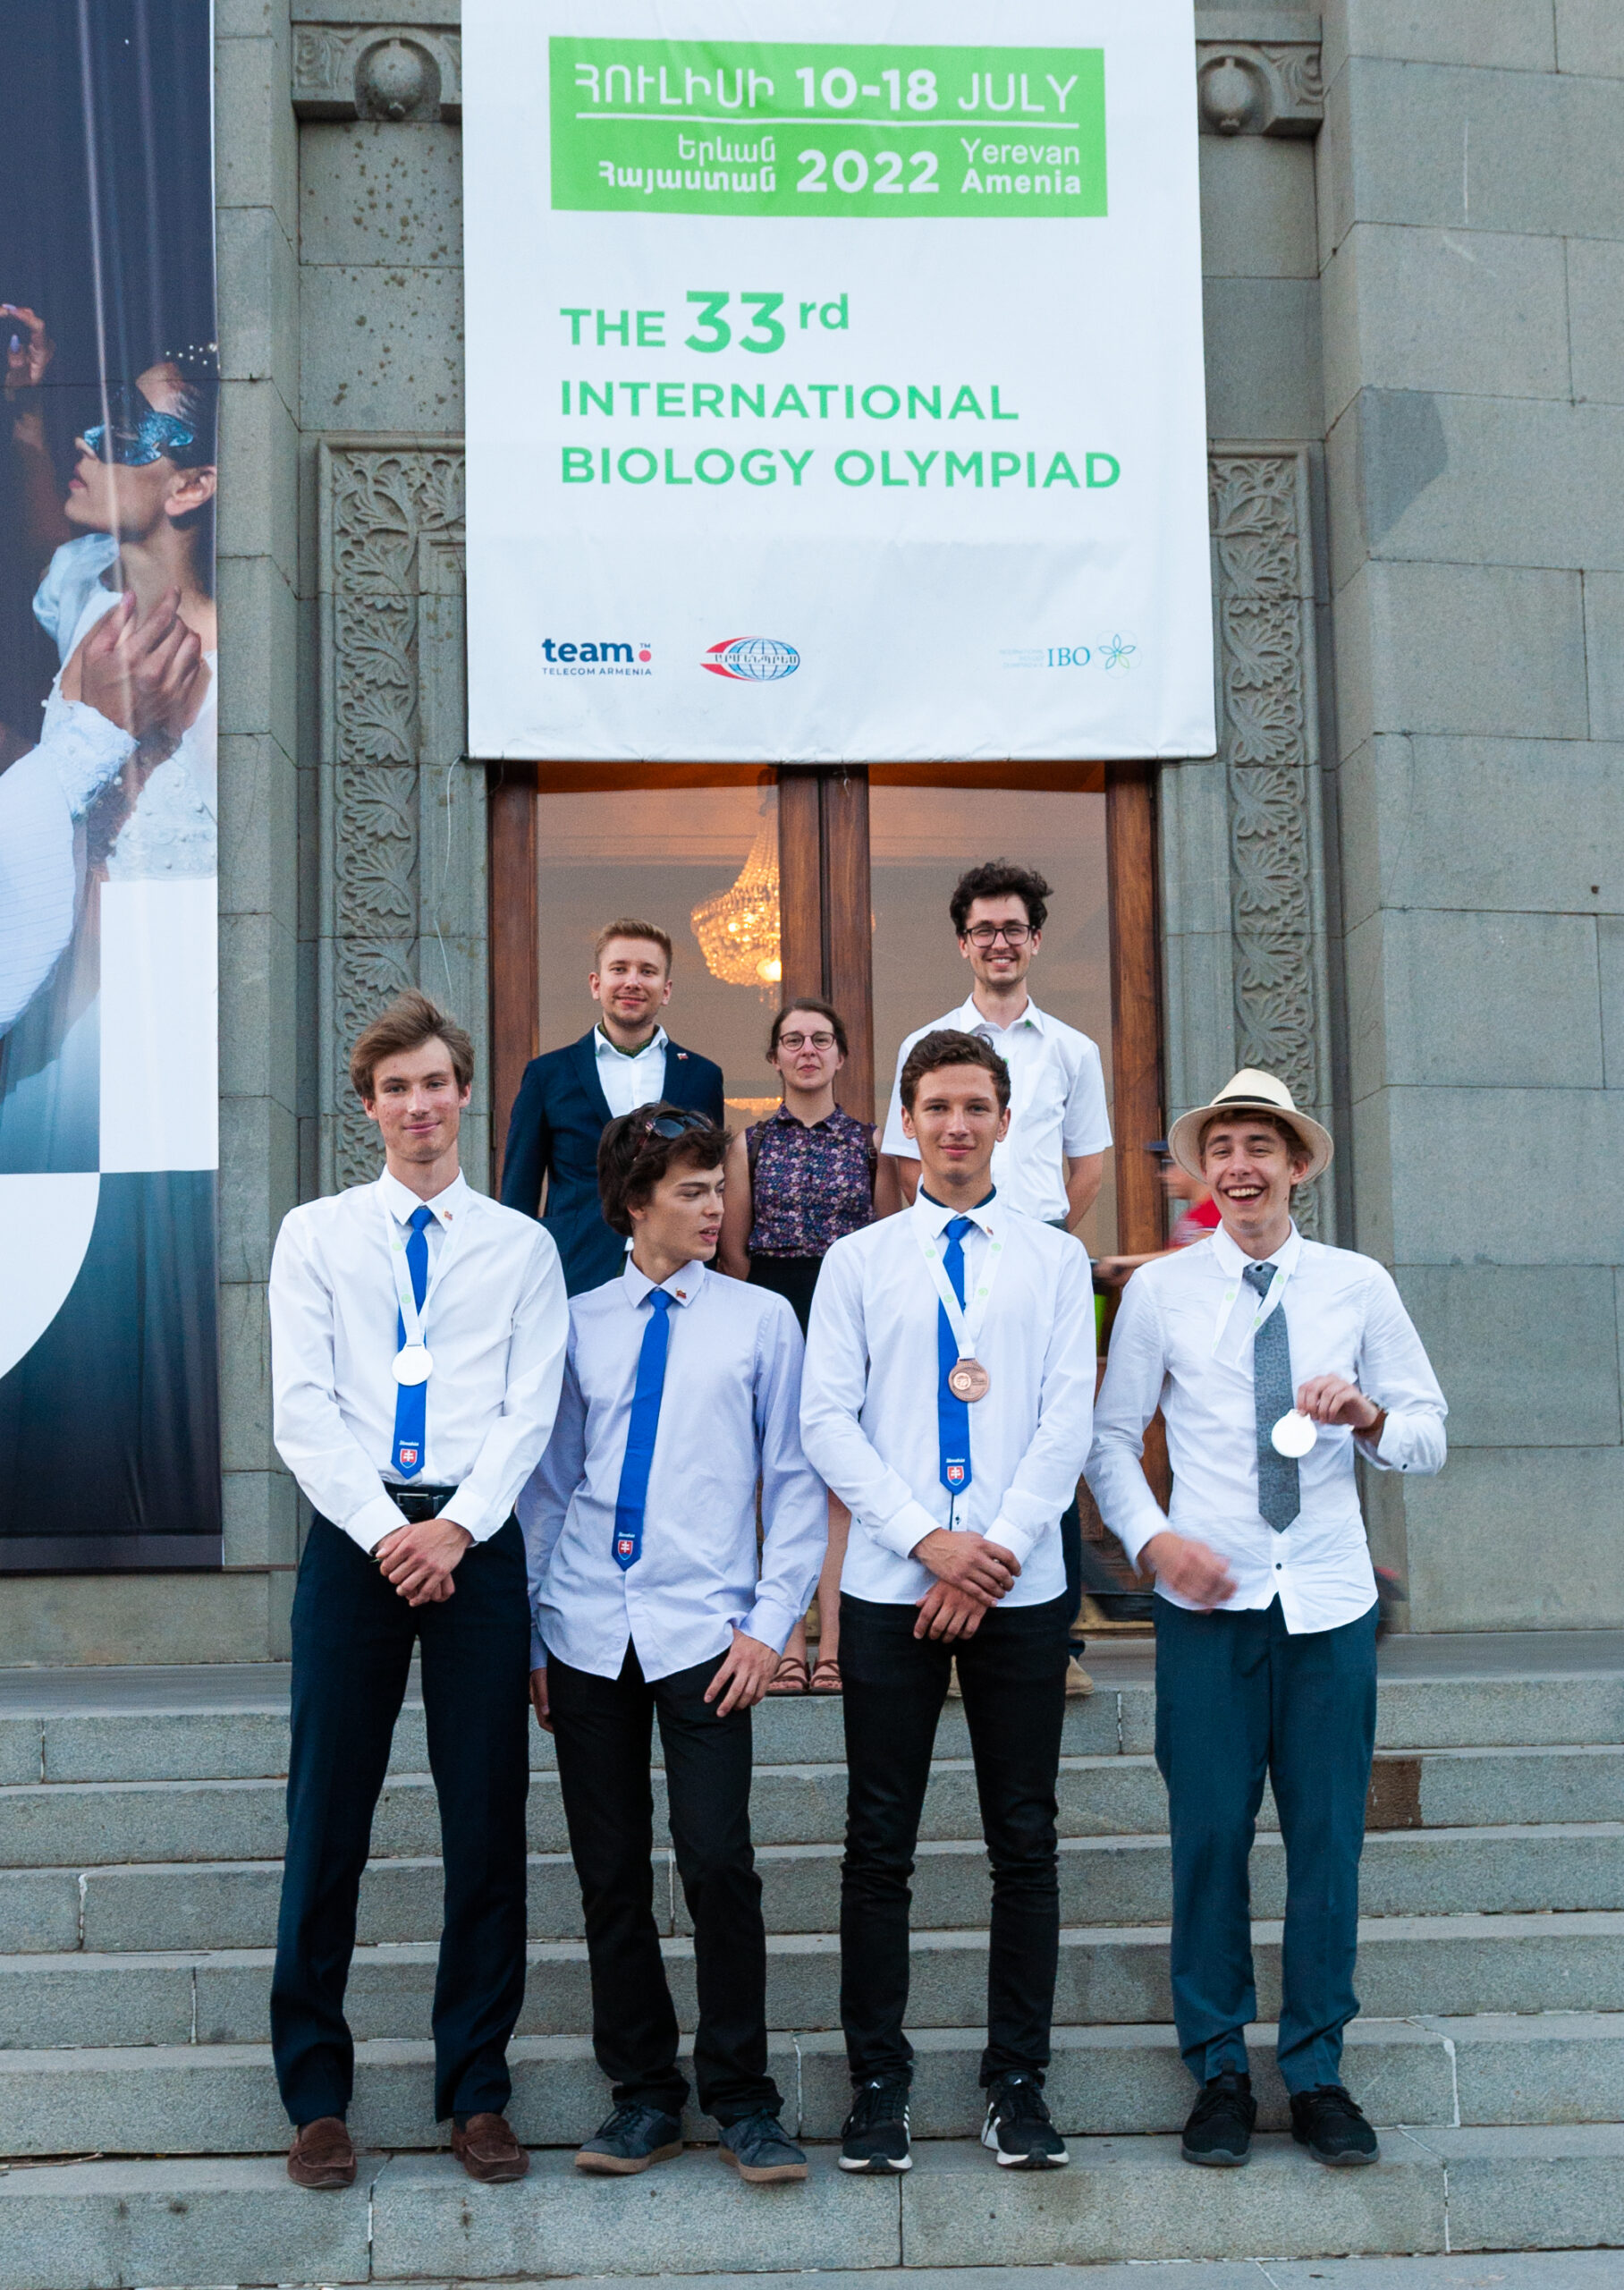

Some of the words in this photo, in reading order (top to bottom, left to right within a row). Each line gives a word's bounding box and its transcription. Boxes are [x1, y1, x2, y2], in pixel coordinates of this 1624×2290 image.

[575, 63, 774, 108] ՀՈՒԼԻՍԻ
[795, 66, 938, 112] 10-18
[958, 72, 1078, 114] JULY
[960, 138, 1080, 165] Yerevan
[598, 159, 776, 195] Հայաստան
[796, 148, 940, 194] 2022
[960, 168, 1081, 195] Amenia
[560, 308, 666, 347] THE
[562, 380, 1019, 420] INTERNATIONAL
[562, 446, 814, 487] BIOLOGY
[834, 449, 1121, 489] OLYMPIAD
[542, 667, 596, 675] TELECOM
[598, 667, 652, 675] ARMENIA
[1047, 646, 1091, 667] IBO
